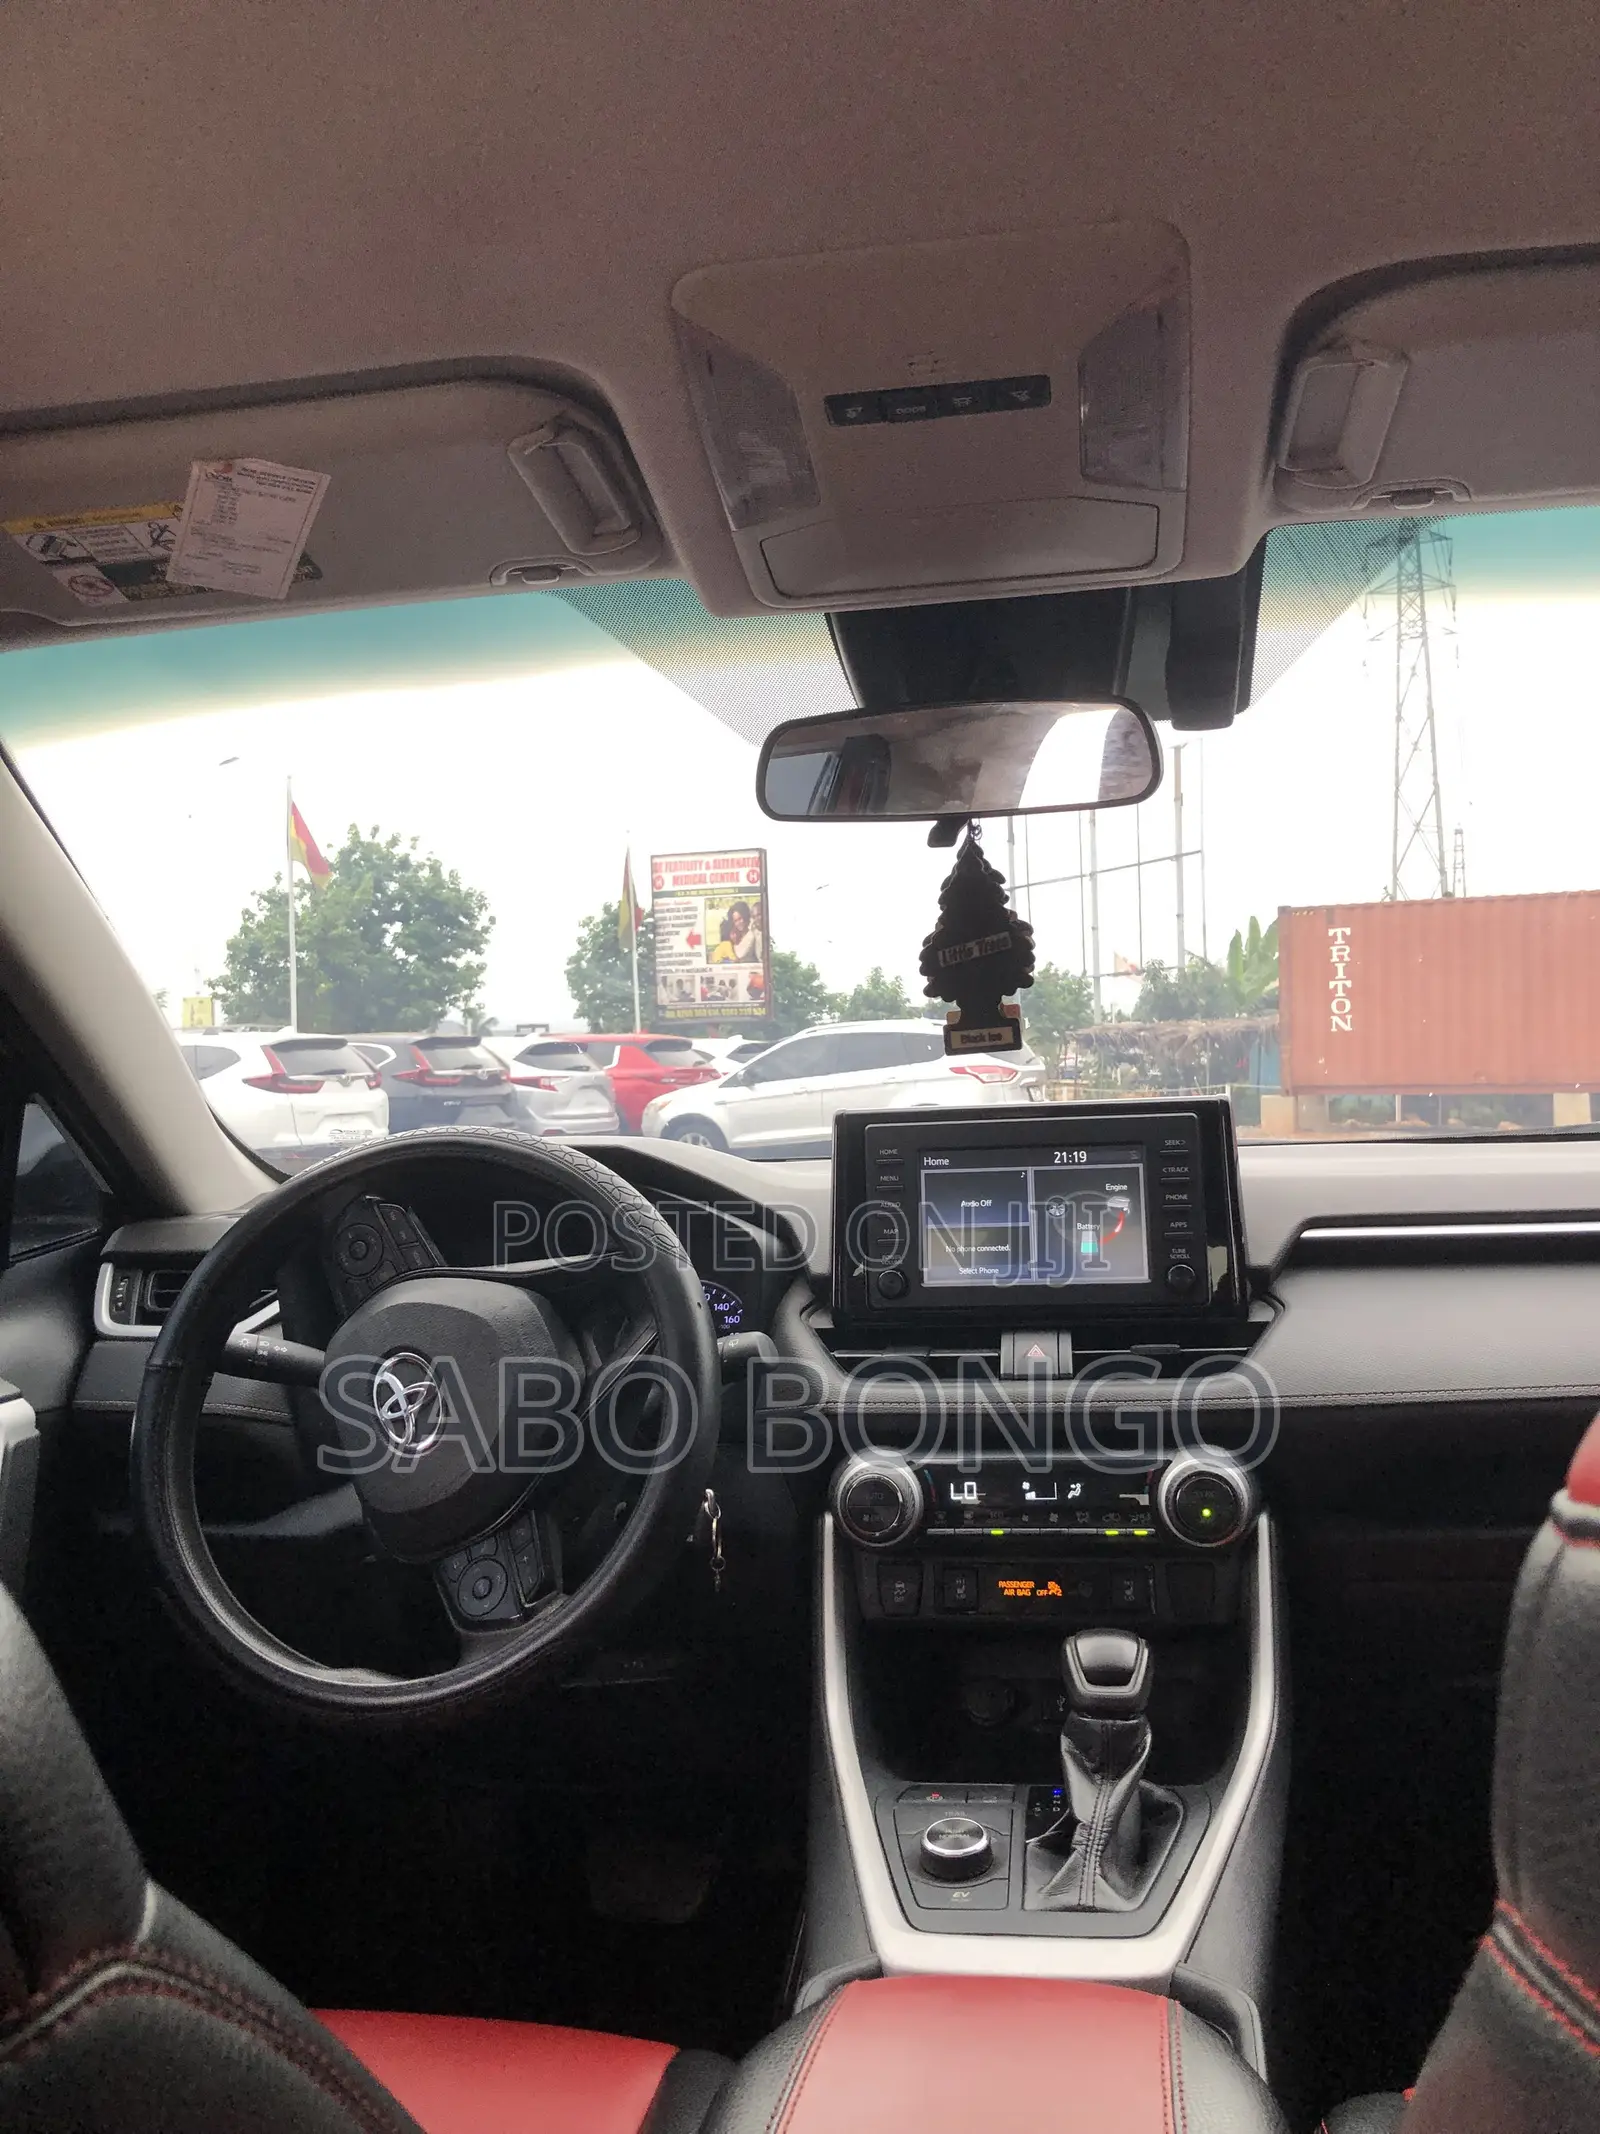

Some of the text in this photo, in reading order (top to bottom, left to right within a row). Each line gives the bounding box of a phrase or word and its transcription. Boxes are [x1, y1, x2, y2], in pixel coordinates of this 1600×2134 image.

[1328, 927, 1353, 1032] TRITON
[960, 1031, 986, 1044] Black
[923, 1150, 1088, 1166] Home 21:19
[1105, 1183, 1128, 1192] Engine
[961, 1199, 993, 1208] Audio Off
[1076, 1222, 1101, 1232] Battery
[945, 1243, 1011, 1255] No phone connected.
[958, 1266, 1000, 1275] Select Phone
[713, 1303, 730, 1311] 140
[724, 1315, 741, 1324] 160
[998, 1580, 1035, 1588] PASSENGER
[1003, 1588, 1016, 1596] AIR
[1016, 1588, 1032, 1597] BAG
[1036, 1589, 1048, 1597] OFF
[952, 1891, 971, 1899] EV
